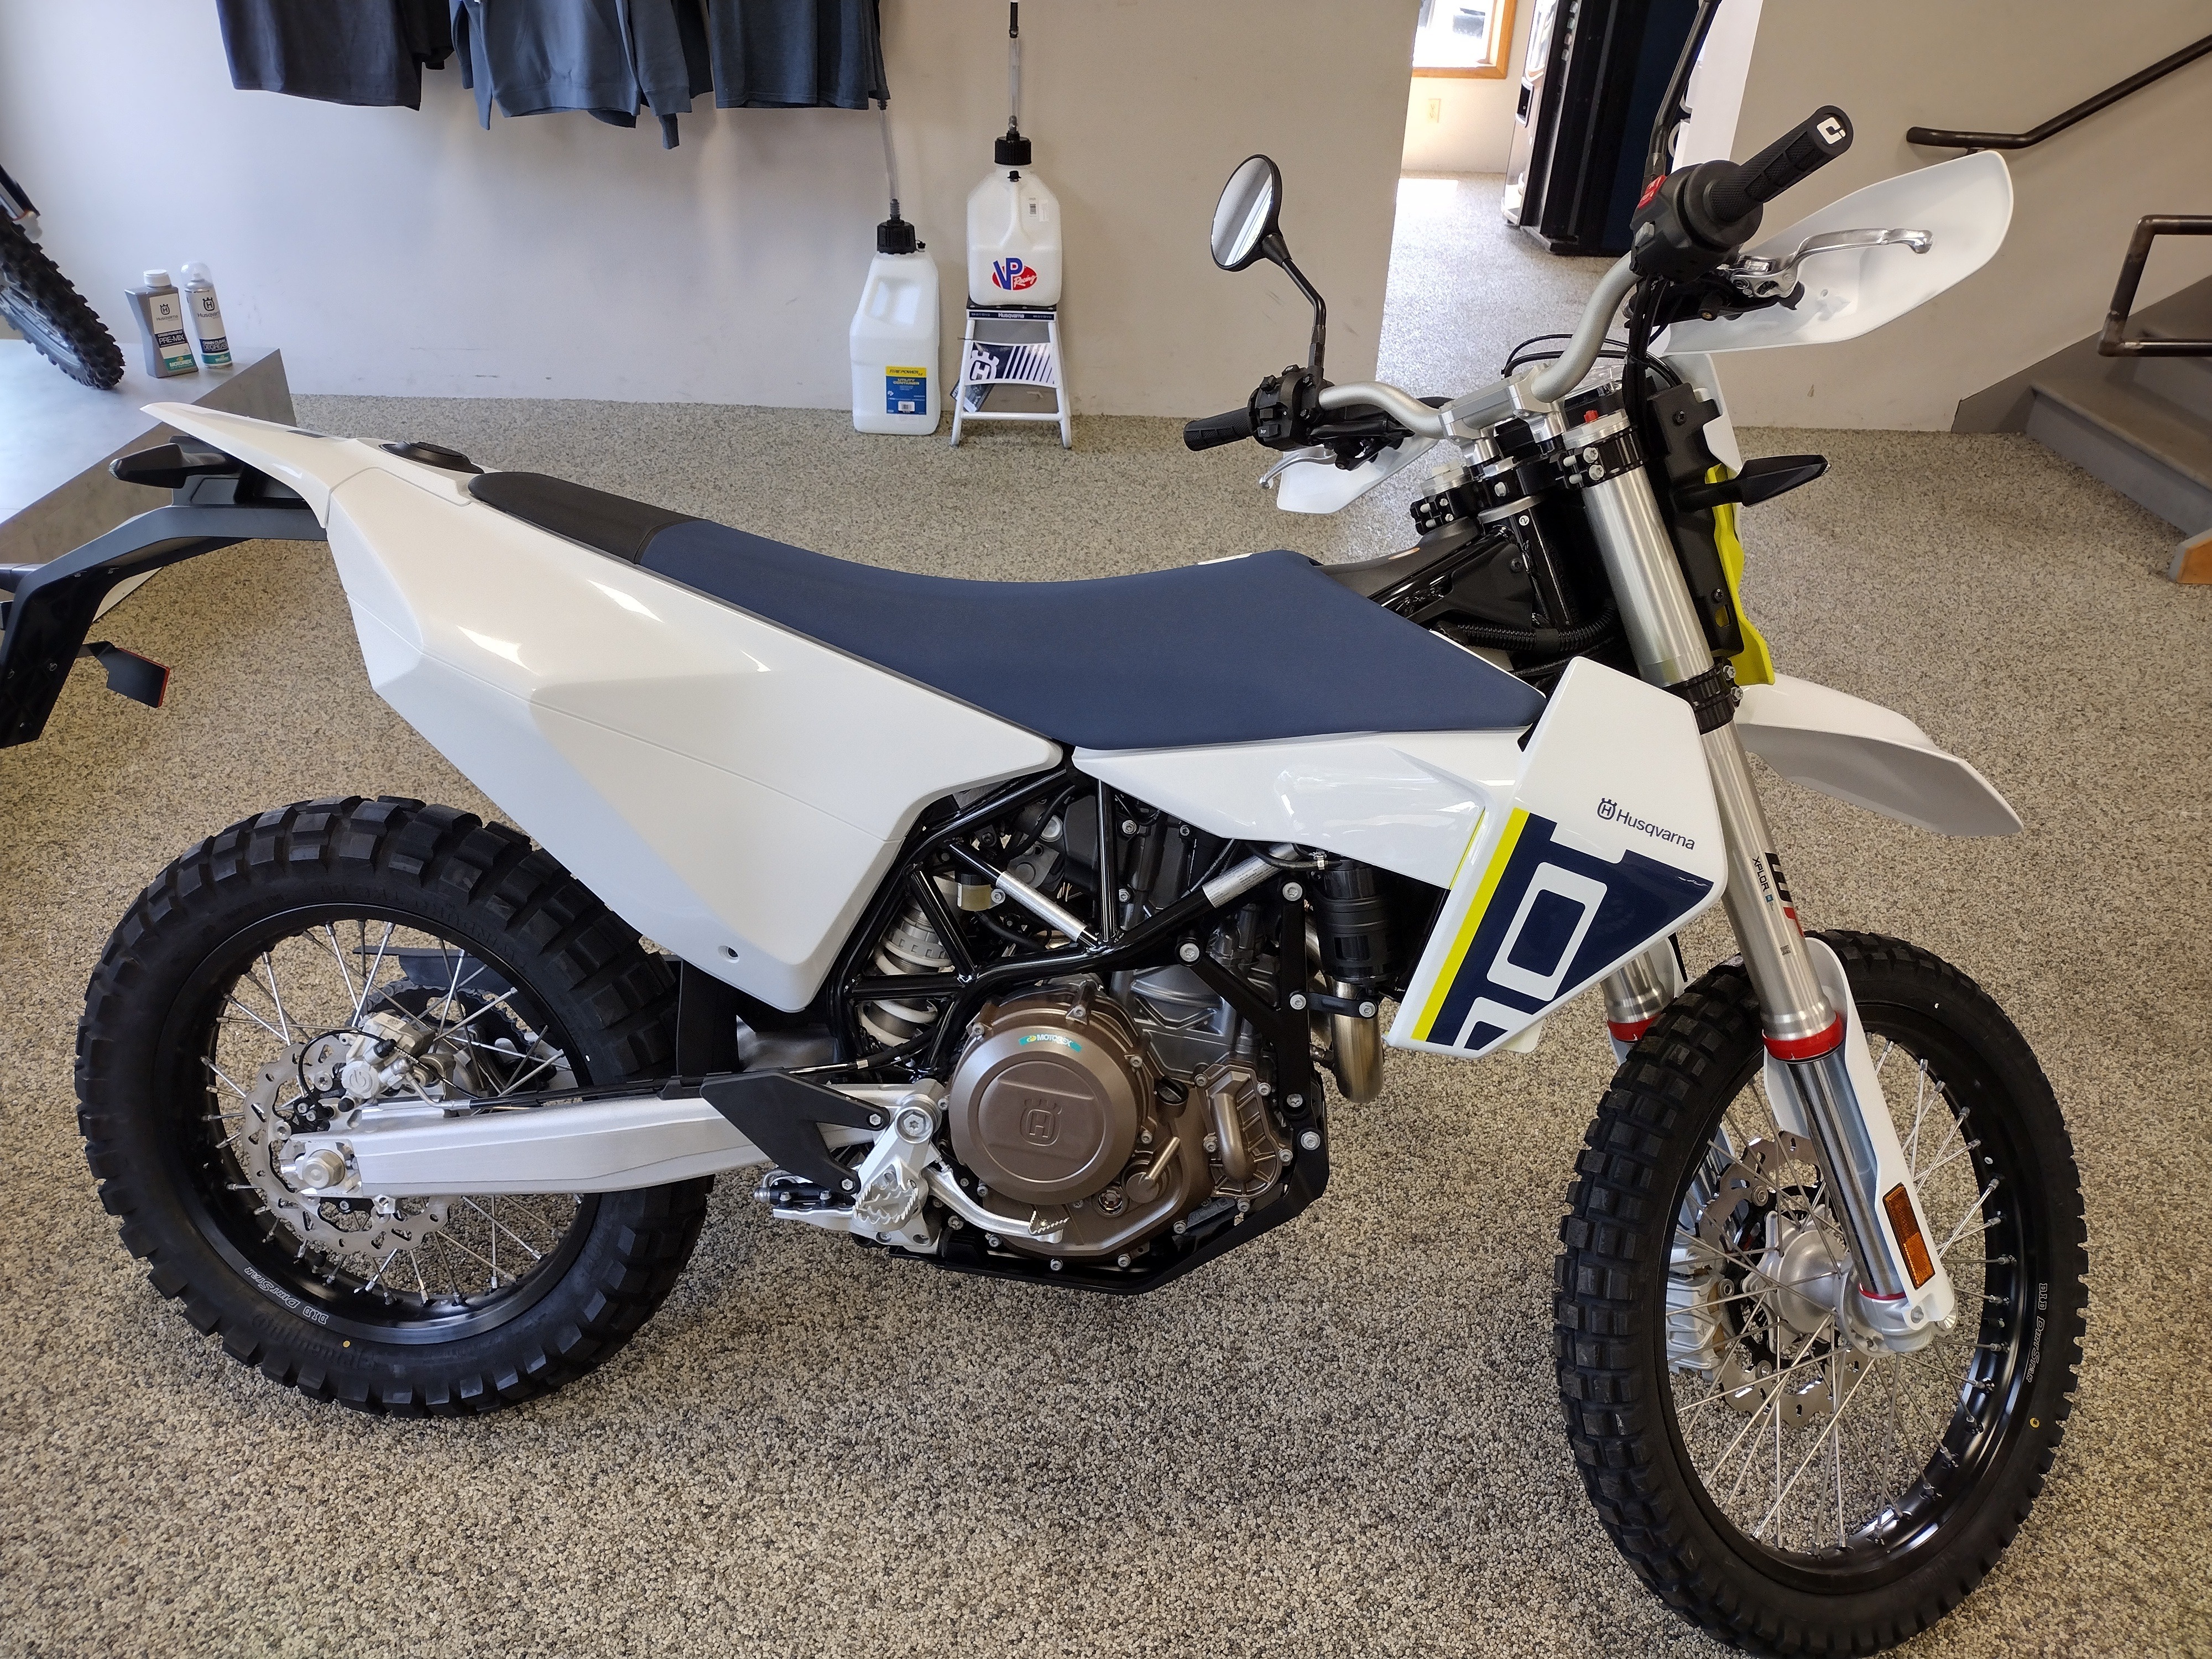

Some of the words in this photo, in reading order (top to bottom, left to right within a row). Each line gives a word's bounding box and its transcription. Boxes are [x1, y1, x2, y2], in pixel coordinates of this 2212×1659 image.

[993, 258, 1022, 290] VP
[1014, 275, 1037, 288] Racing
[159, 335, 185, 344] PRE-MIX
[1616, 809, 1695, 850] Husqvarna
[1752, 855, 1770, 892] XPLOR
[1036, 1034, 1073, 1046] MOTOREX
[2038, 1282, 2047, 1310] DID
[302, 1306, 329, 1325] DID
